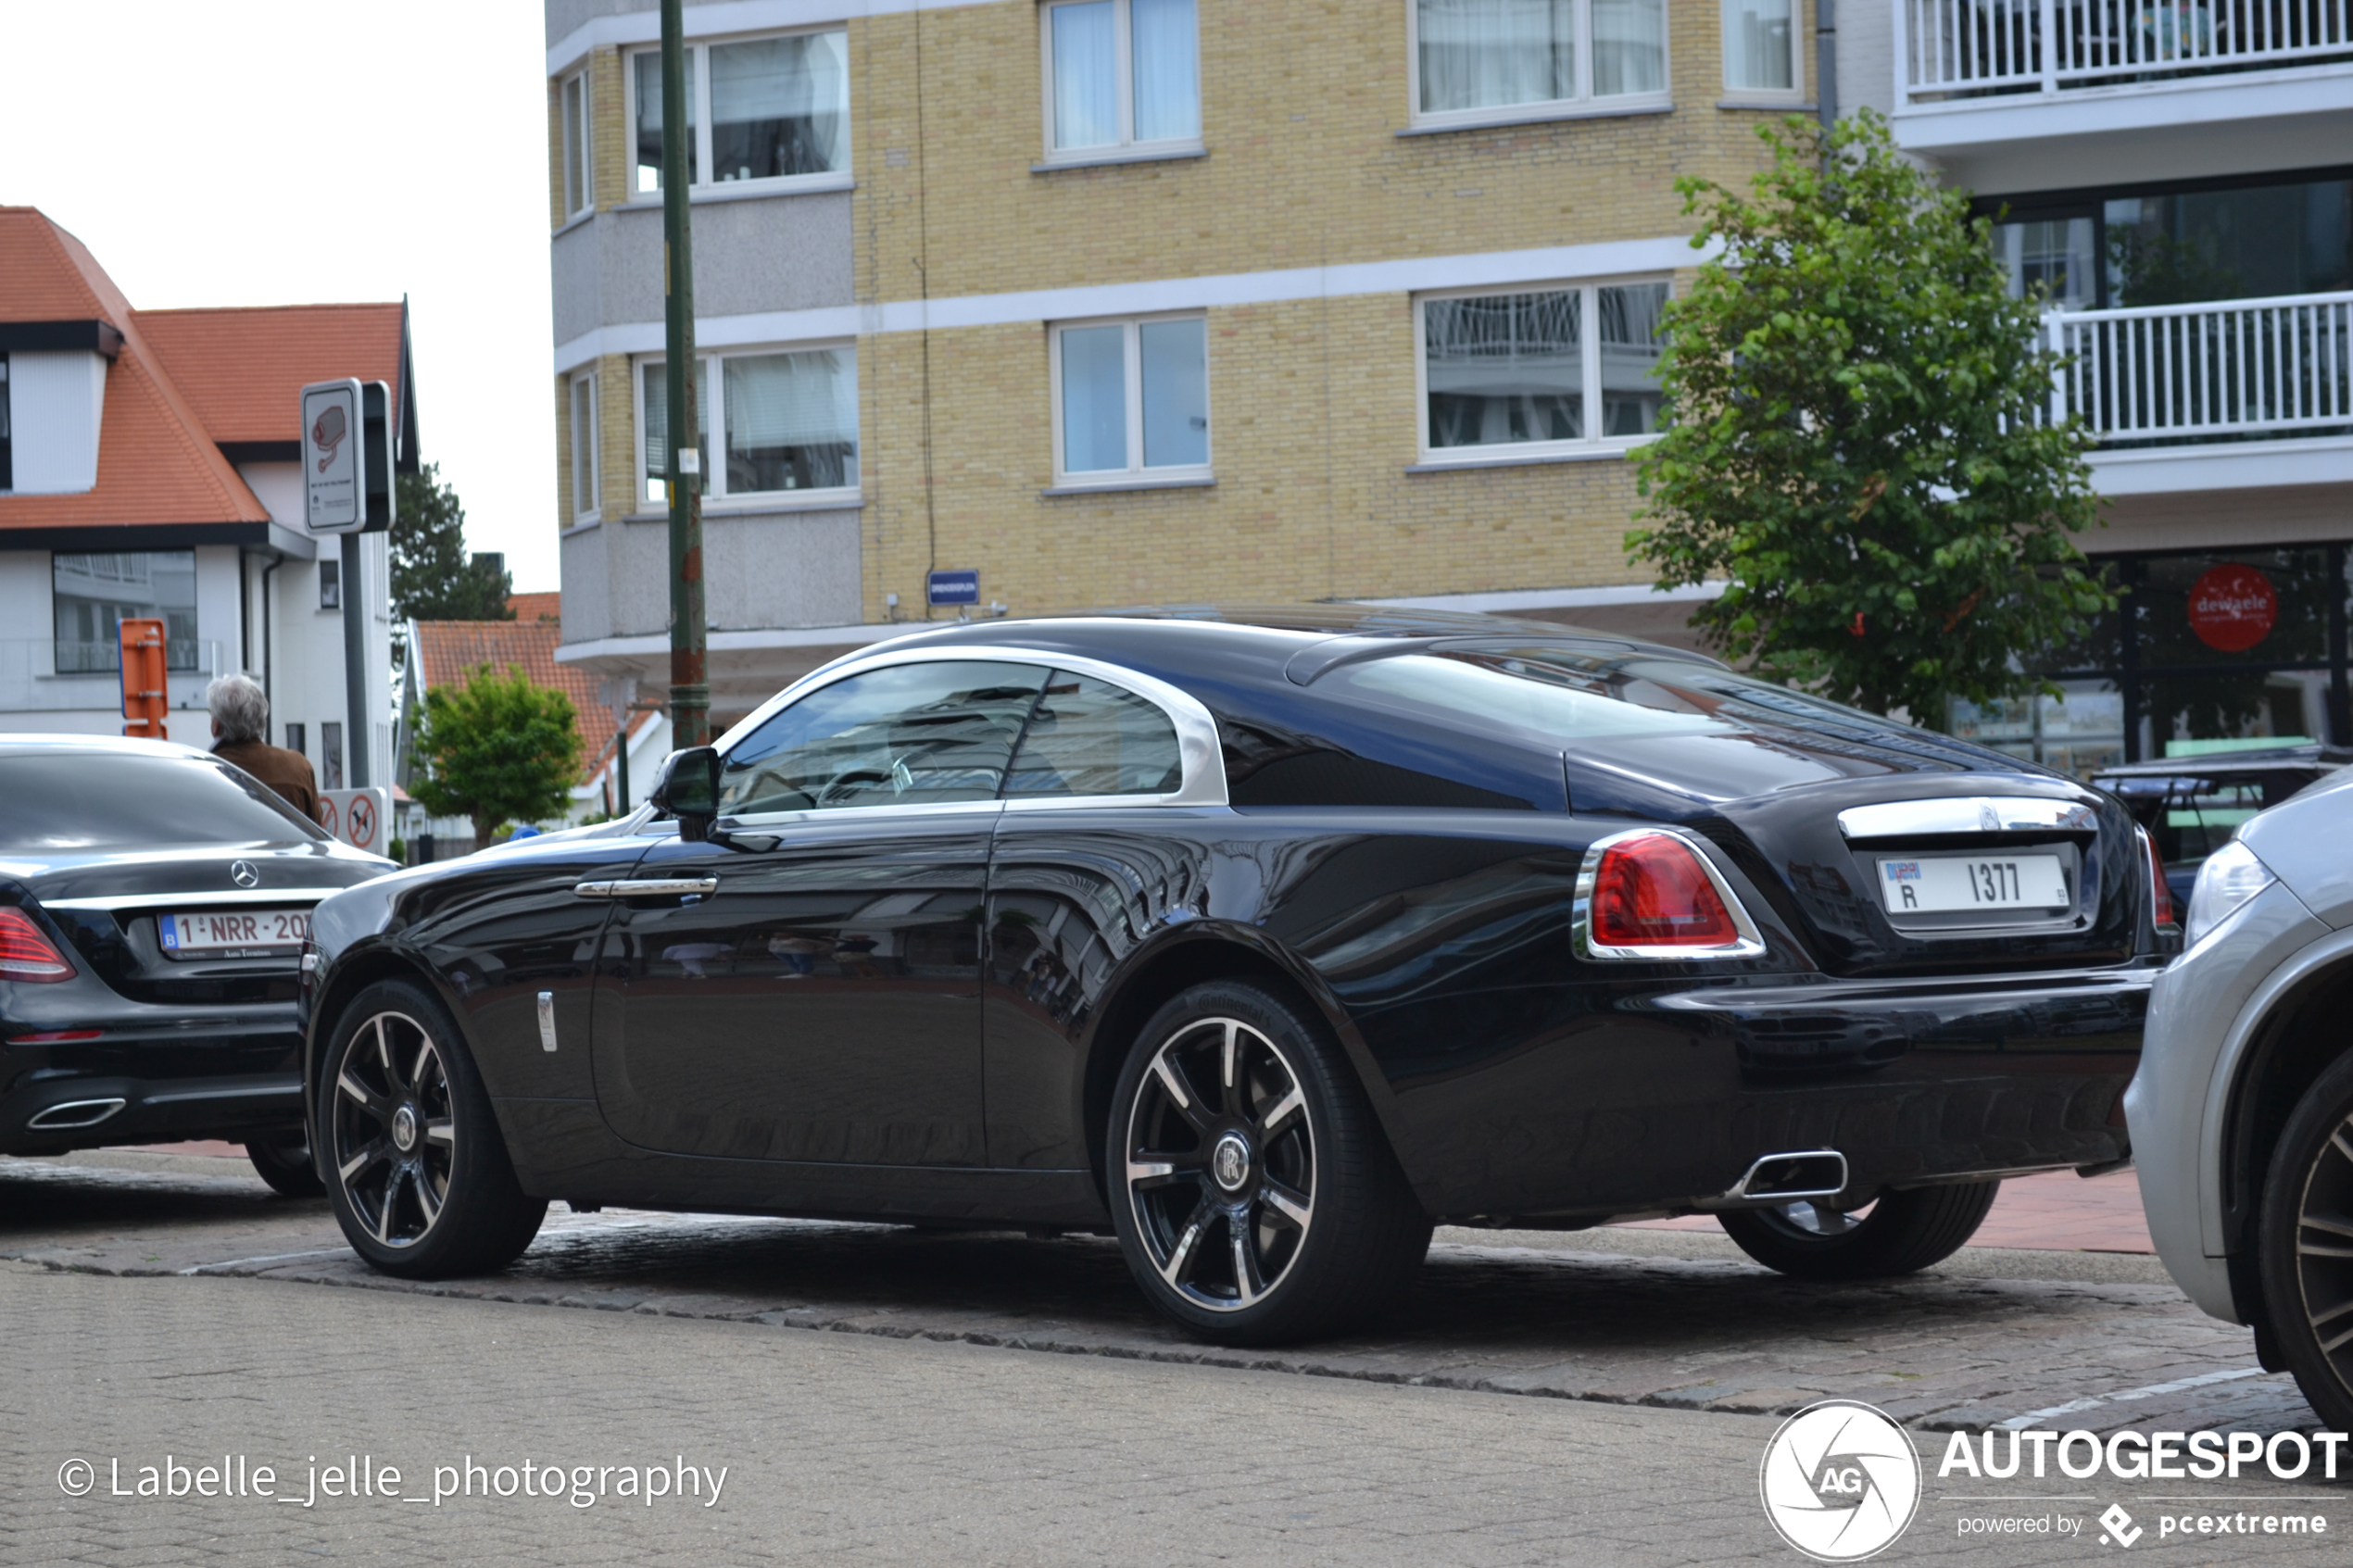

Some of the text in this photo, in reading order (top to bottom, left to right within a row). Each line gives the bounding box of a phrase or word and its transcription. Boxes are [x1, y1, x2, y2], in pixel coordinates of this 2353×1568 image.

[2197, 595, 2267, 613] dewaele
[1968, 862, 2020, 902] 1377
[1901, 884, 1919, 909] R
[165, 934, 176, 947] B
[1199, 994, 1265, 1021] Continental
